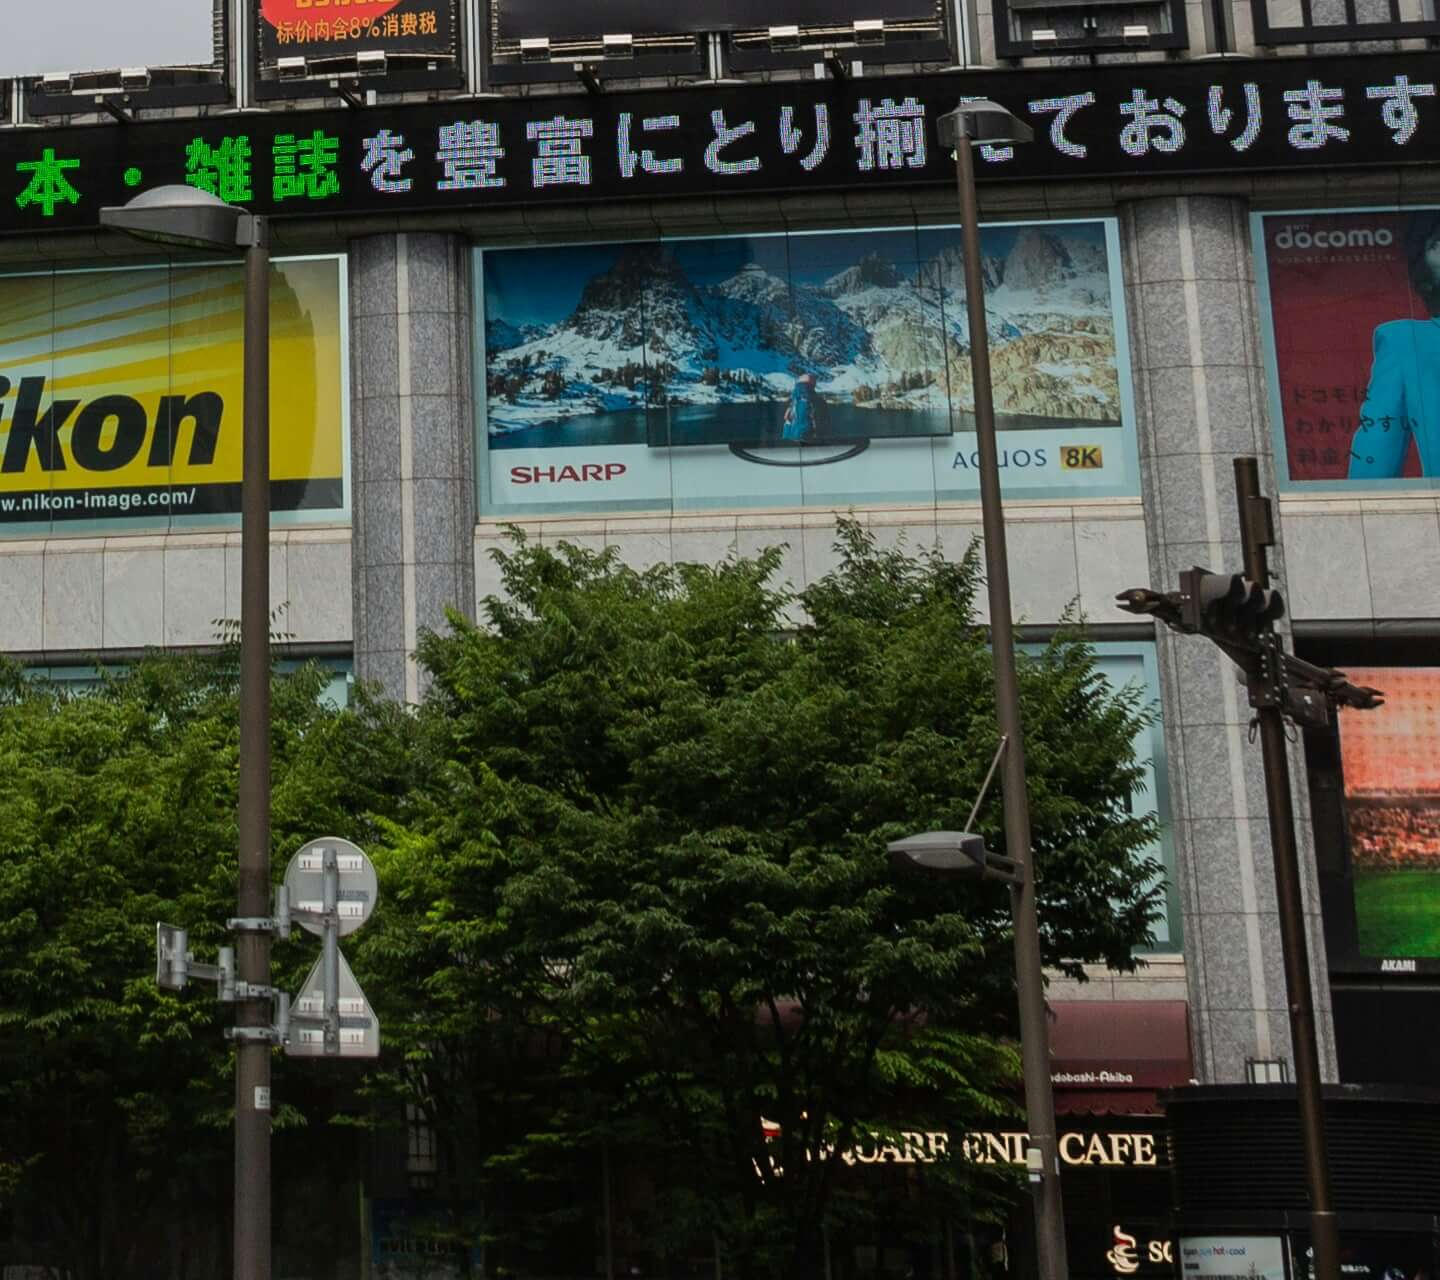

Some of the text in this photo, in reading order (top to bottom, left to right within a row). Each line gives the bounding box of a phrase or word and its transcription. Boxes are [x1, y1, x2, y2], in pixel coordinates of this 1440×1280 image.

[275, 10, 438, 46] 标价内含8%消费税
[1274, 223, 1393, 249] docomo
[510, 461, 627, 484] SHARP
[1059, 1132, 1158, 1166] CAFE
